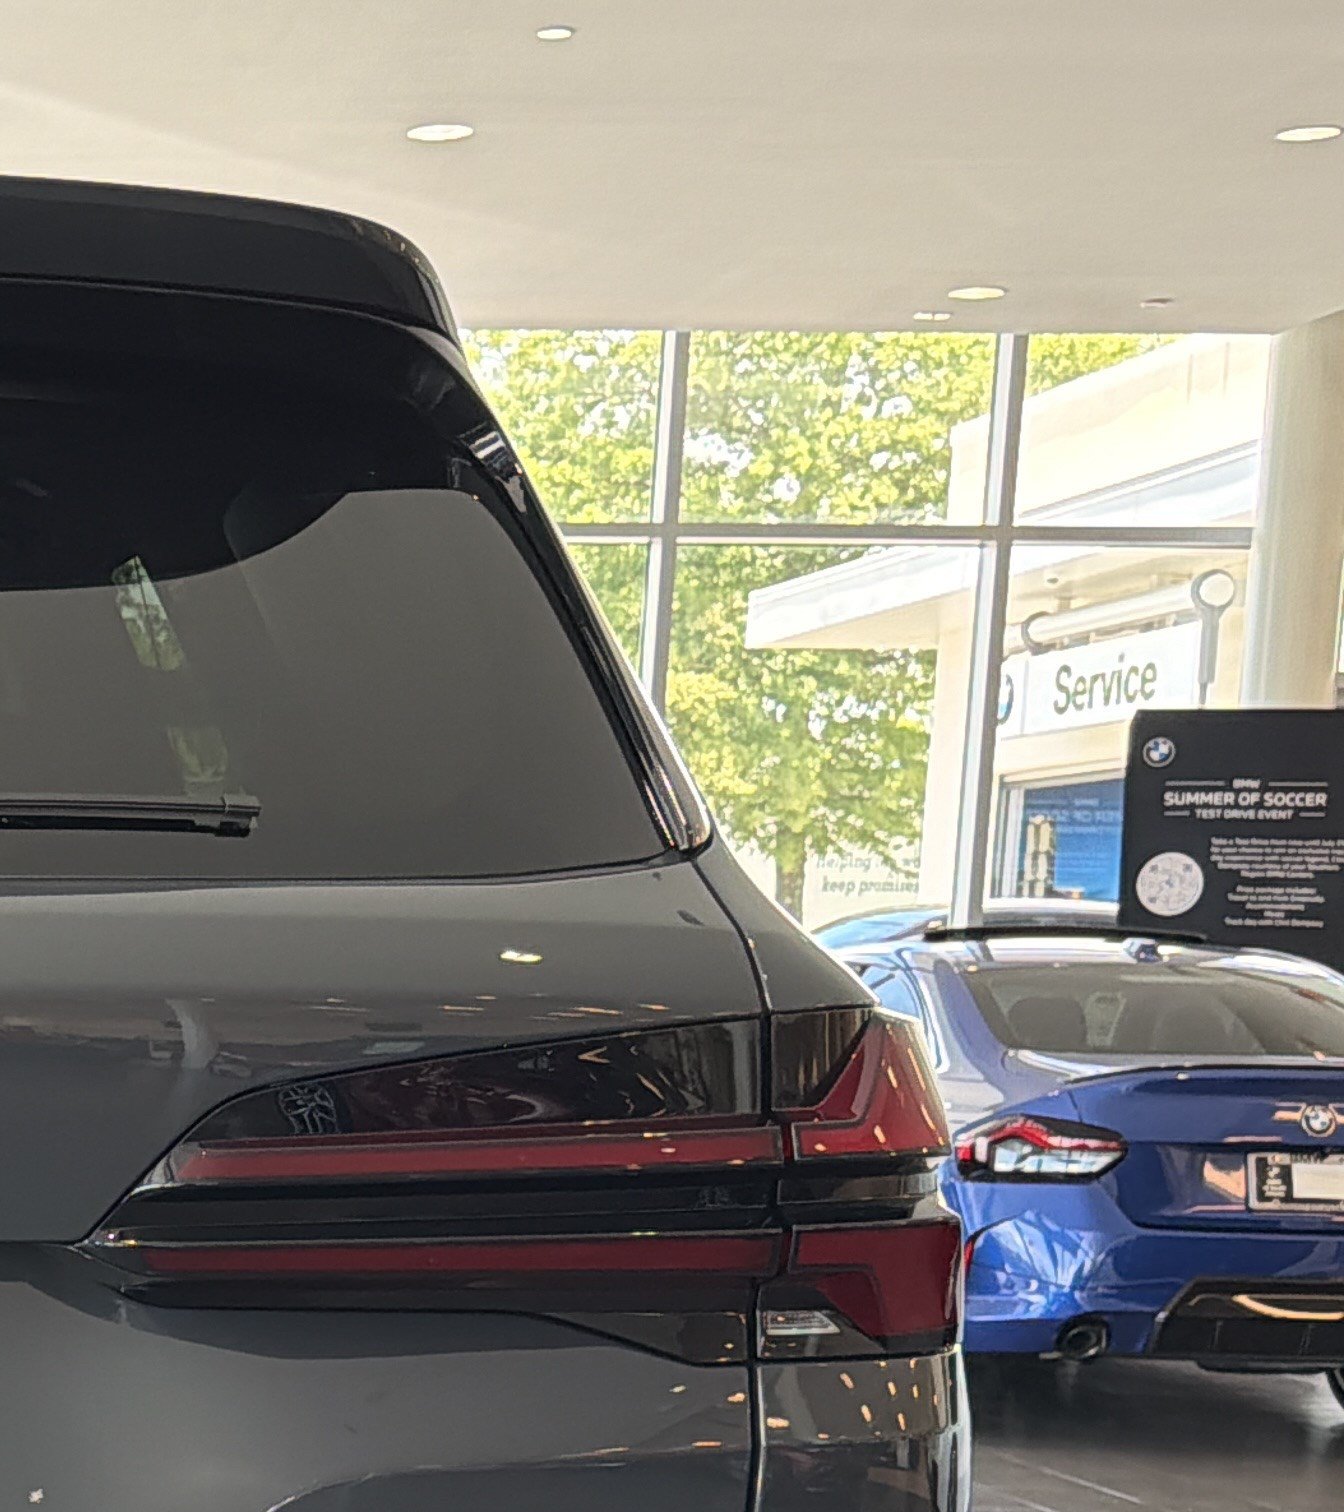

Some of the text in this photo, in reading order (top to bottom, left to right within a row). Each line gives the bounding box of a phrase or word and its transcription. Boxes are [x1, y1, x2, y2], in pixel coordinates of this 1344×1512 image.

[1053, 651, 1158, 715] Service
[1163, 791, 1328, 808] SUMMER OF SOCCER
[1194, 808, 1295, 820] TEST DRIVE EVENT
[822, 874, 856, 896] keep
